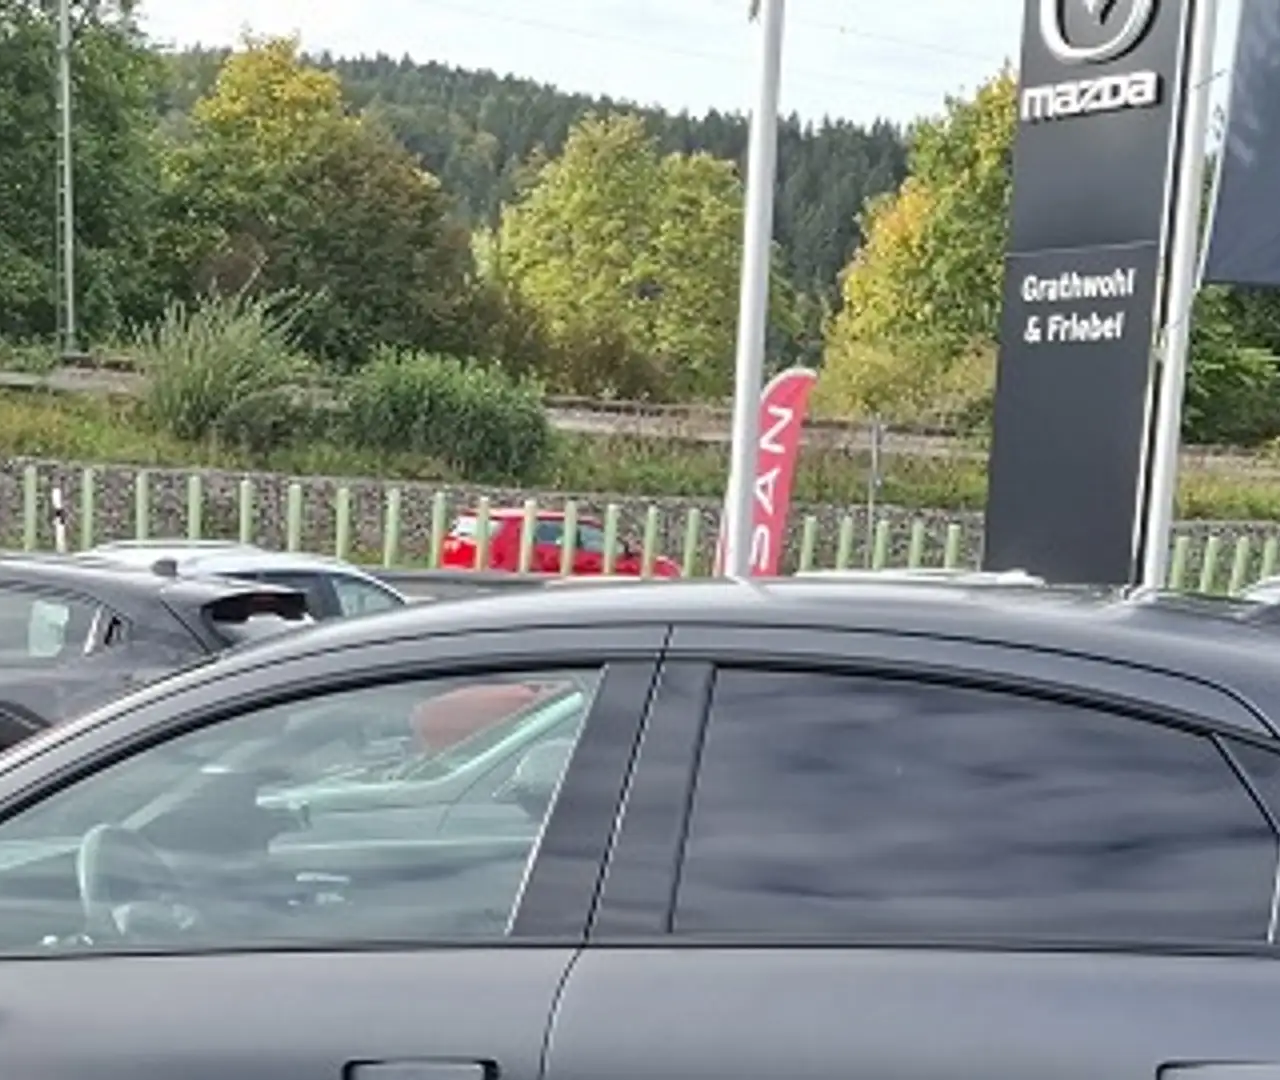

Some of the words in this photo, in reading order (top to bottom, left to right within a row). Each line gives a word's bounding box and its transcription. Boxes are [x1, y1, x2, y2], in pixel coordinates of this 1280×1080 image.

[1022, 267, 1136, 302] Grathwohl
[1024, 314, 1042, 343] &
[1047, 310, 1125, 342] Friebel
